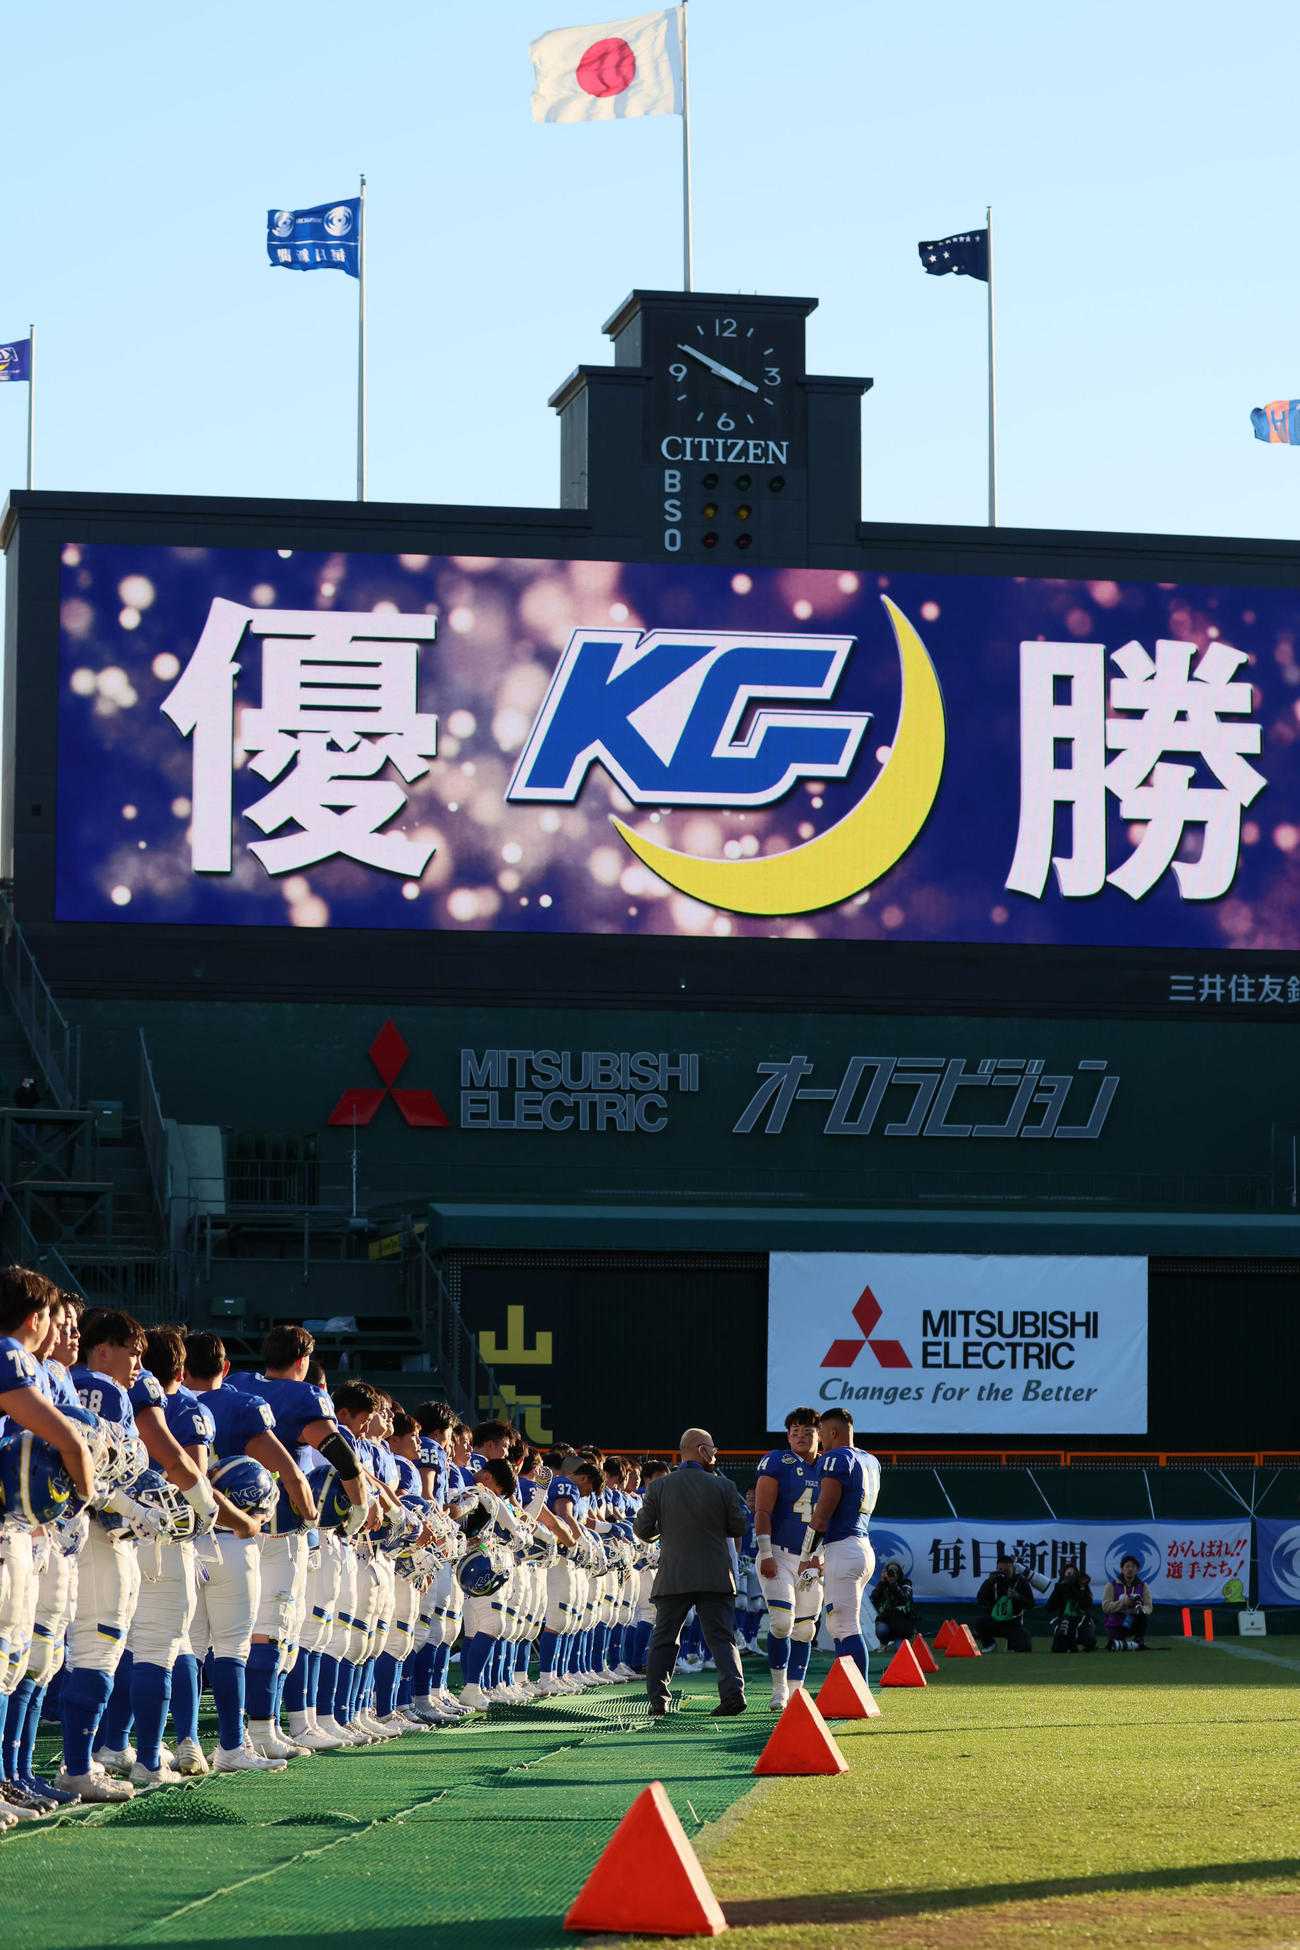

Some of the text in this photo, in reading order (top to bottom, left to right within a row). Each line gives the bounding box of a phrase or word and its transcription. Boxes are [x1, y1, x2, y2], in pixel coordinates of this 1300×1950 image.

[715, 318, 737, 337] 12
[669, 363, 688, 382] 9
[764, 367, 782, 386] 3
[716, 412, 736, 432] 6
[661, 435, 789, 465] CITIZEN
[664, 469, 682, 493] B
[664, 499, 682, 522] S
[505, 626, 873, 807] KG
[160, 597, 438, 877] 優
[1005, 638, 1267, 902] 勝
[460, 1048, 700, 1092] MITSUBISHI
[732, 1055, 1121, 1139] オーロラビジョン
[460, 1091, 669, 1132] ELECTRIC
[922, 1309, 1099, 1339] MITSUBISHI
[922, 1341, 1075, 1370] ELECTRIC
[819, 1377, 1098, 1405] Changes for the Better
[420, 1448, 439, 1465] 52
[823, 1456, 837, 1471] 11
[557, 1483, 573, 1496] 37
[928, 1537, 1088, 1579] 毎日新聞
